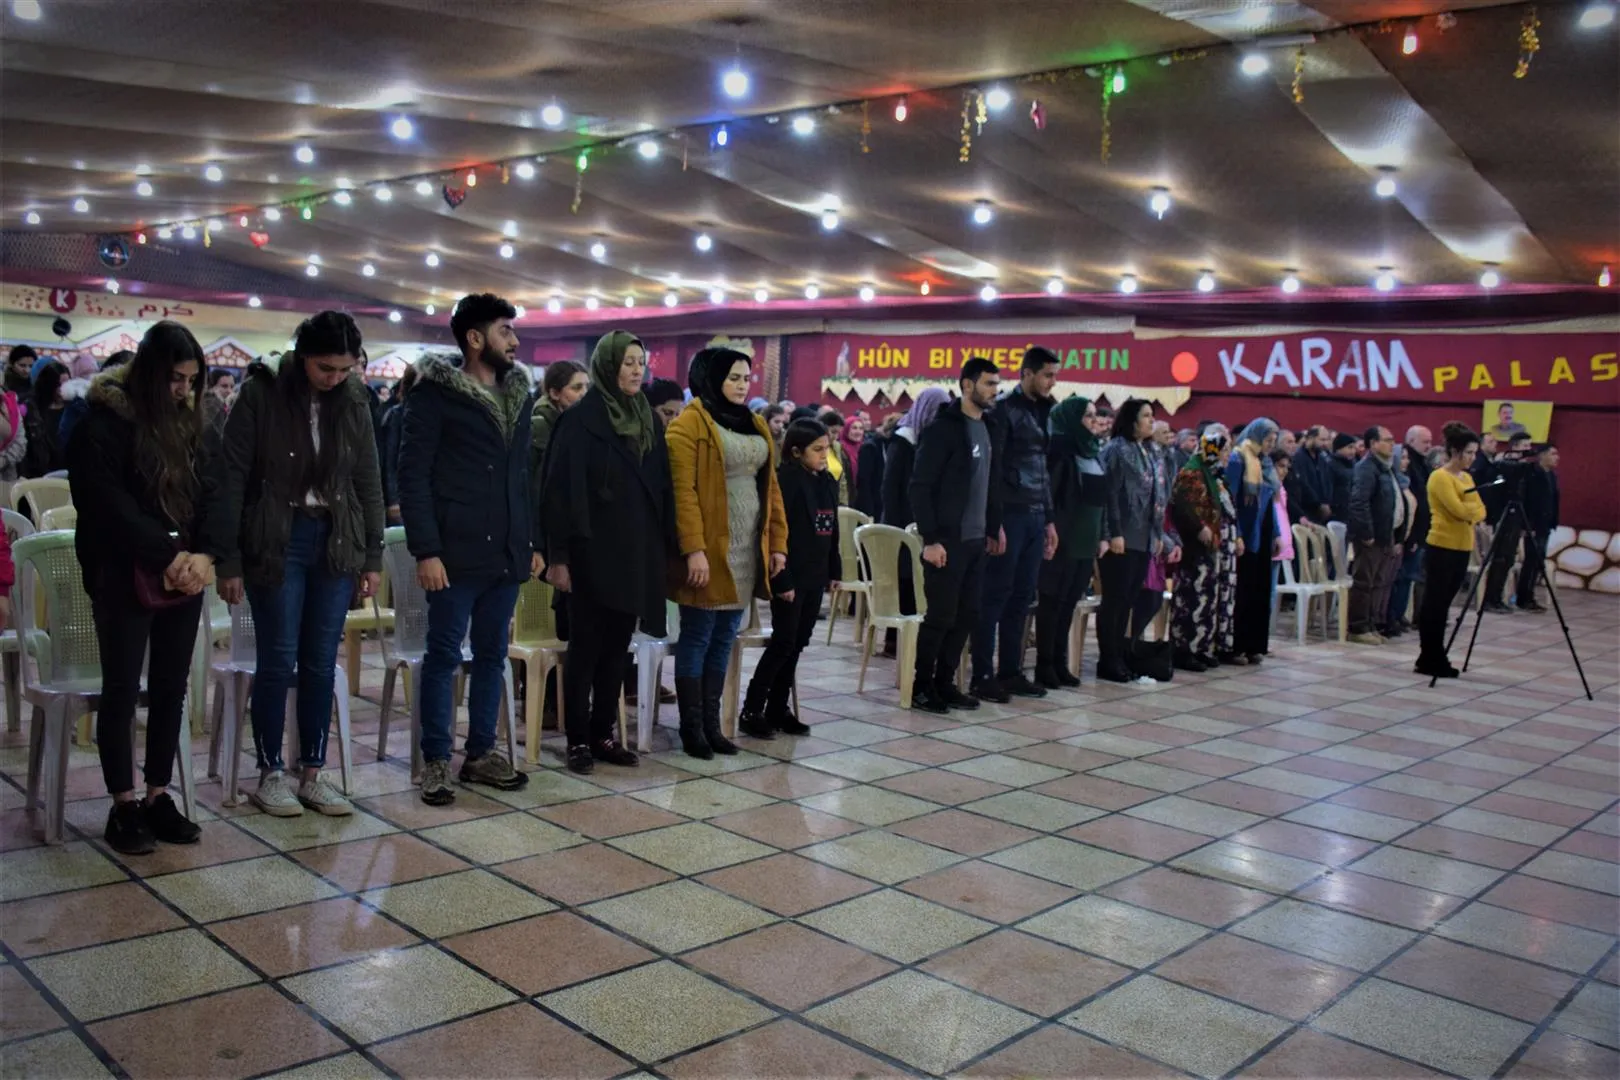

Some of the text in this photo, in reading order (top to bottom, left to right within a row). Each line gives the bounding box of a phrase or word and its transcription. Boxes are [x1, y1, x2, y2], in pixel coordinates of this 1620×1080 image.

[56, 288, 69, 308] K
[138, 303, 193, 318] كرم
[858, 342, 910, 368] HÛN
[928, 348, 953, 368] BI
[960, 343, 1034, 371] XWEŞ
[1218, 337, 1619, 393] KARAM PALAS
